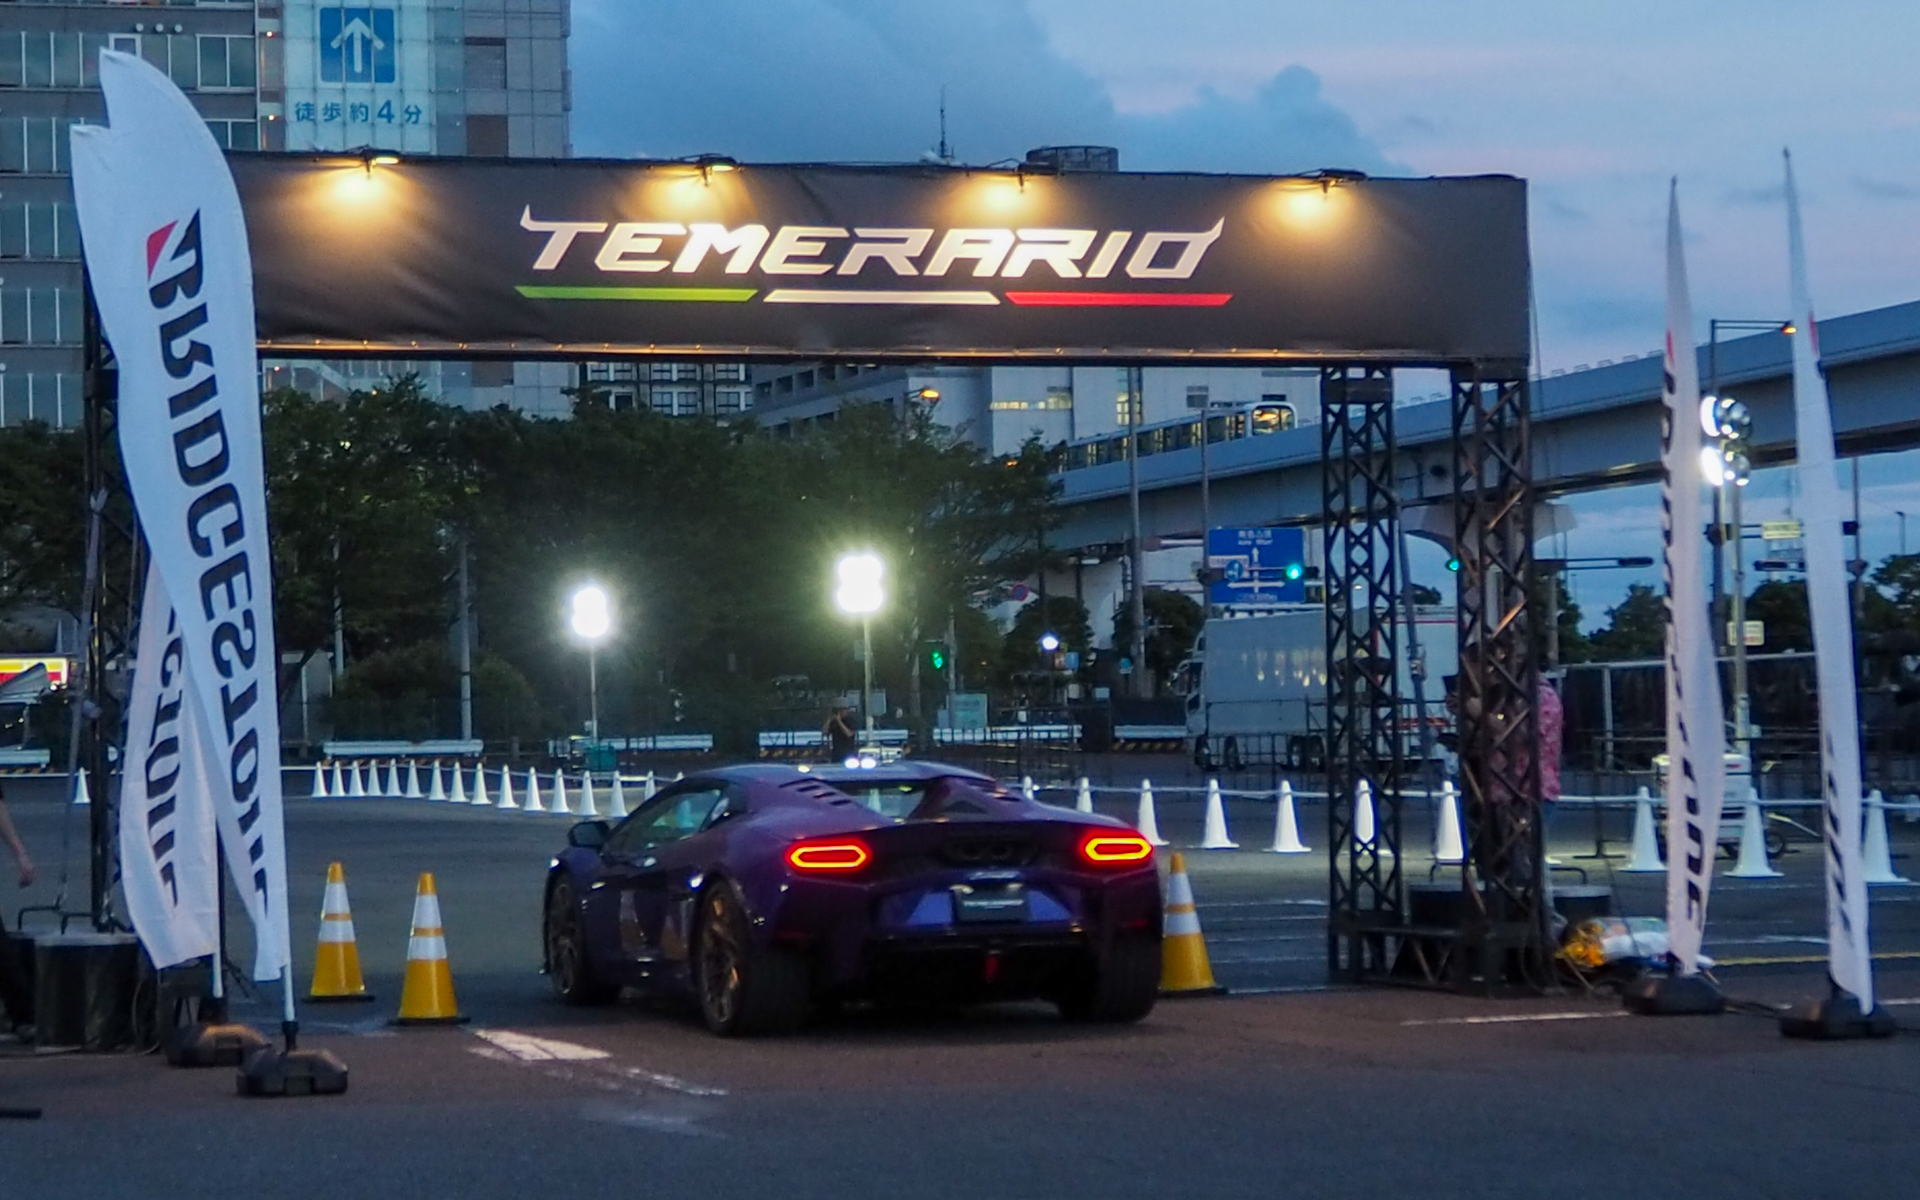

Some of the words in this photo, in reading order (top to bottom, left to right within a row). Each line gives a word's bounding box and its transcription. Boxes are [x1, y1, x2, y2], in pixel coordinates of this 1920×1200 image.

[295, 99, 422, 124] 徒歩約4分
[519, 204, 1225, 278] TEMERARIO
